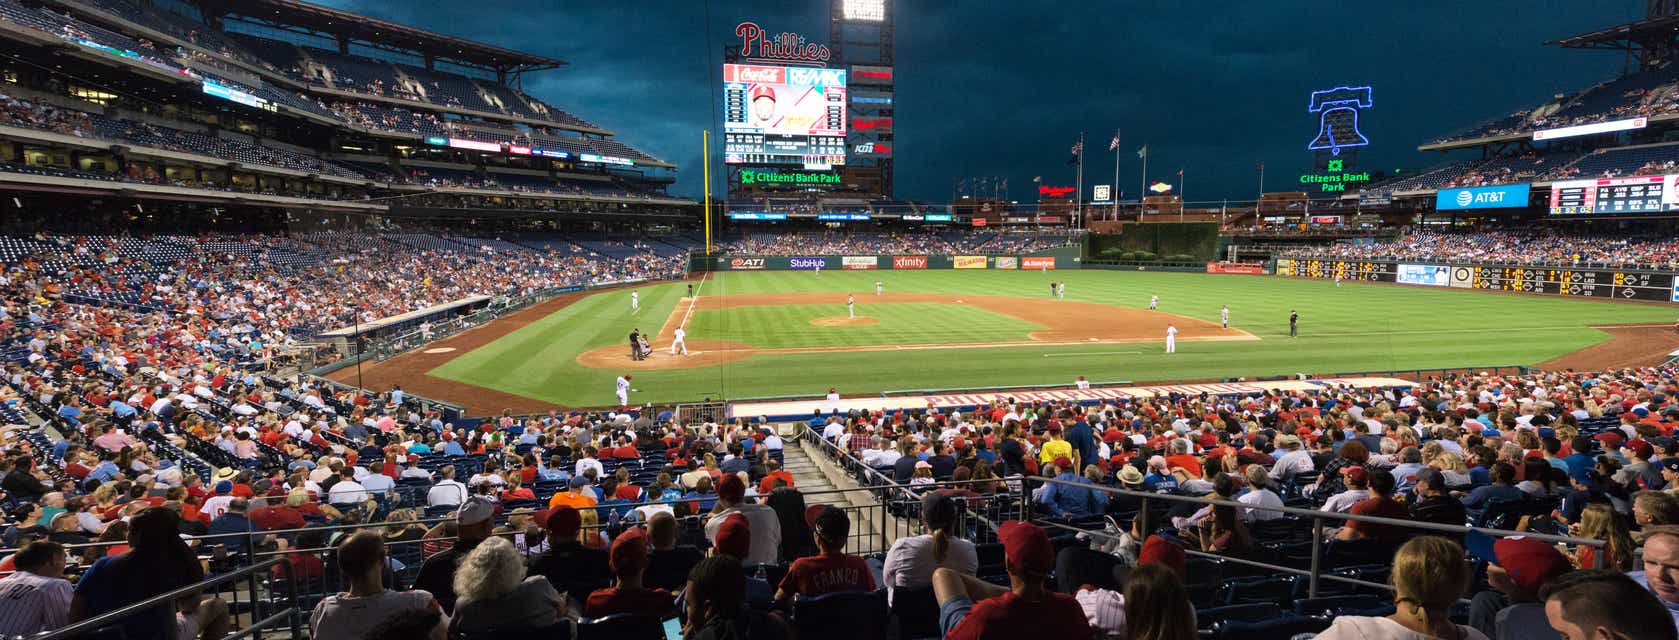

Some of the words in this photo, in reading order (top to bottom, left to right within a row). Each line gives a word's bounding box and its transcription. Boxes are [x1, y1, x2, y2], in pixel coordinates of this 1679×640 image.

[736, 22, 830, 61] Phillies
[757, 172, 794, 182] Citizens
[796, 173, 819, 182] Bank
[820, 174, 840, 183] Park
[1300, 174, 1341, 182] Citizens
[1343, 173, 1370, 181] Bank
[1322, 182, 1344, 191] Park
[1474, 192, 1505, 202] AT&T
[742, 258, 764, 266] ATI
[790, 259, 825, 268] StubHub
[896, 258, 925, 269] xfinity
[925, 388, 1128, 407] PHILADELPHIA
[811, 569, 860, 591] FRANCO
